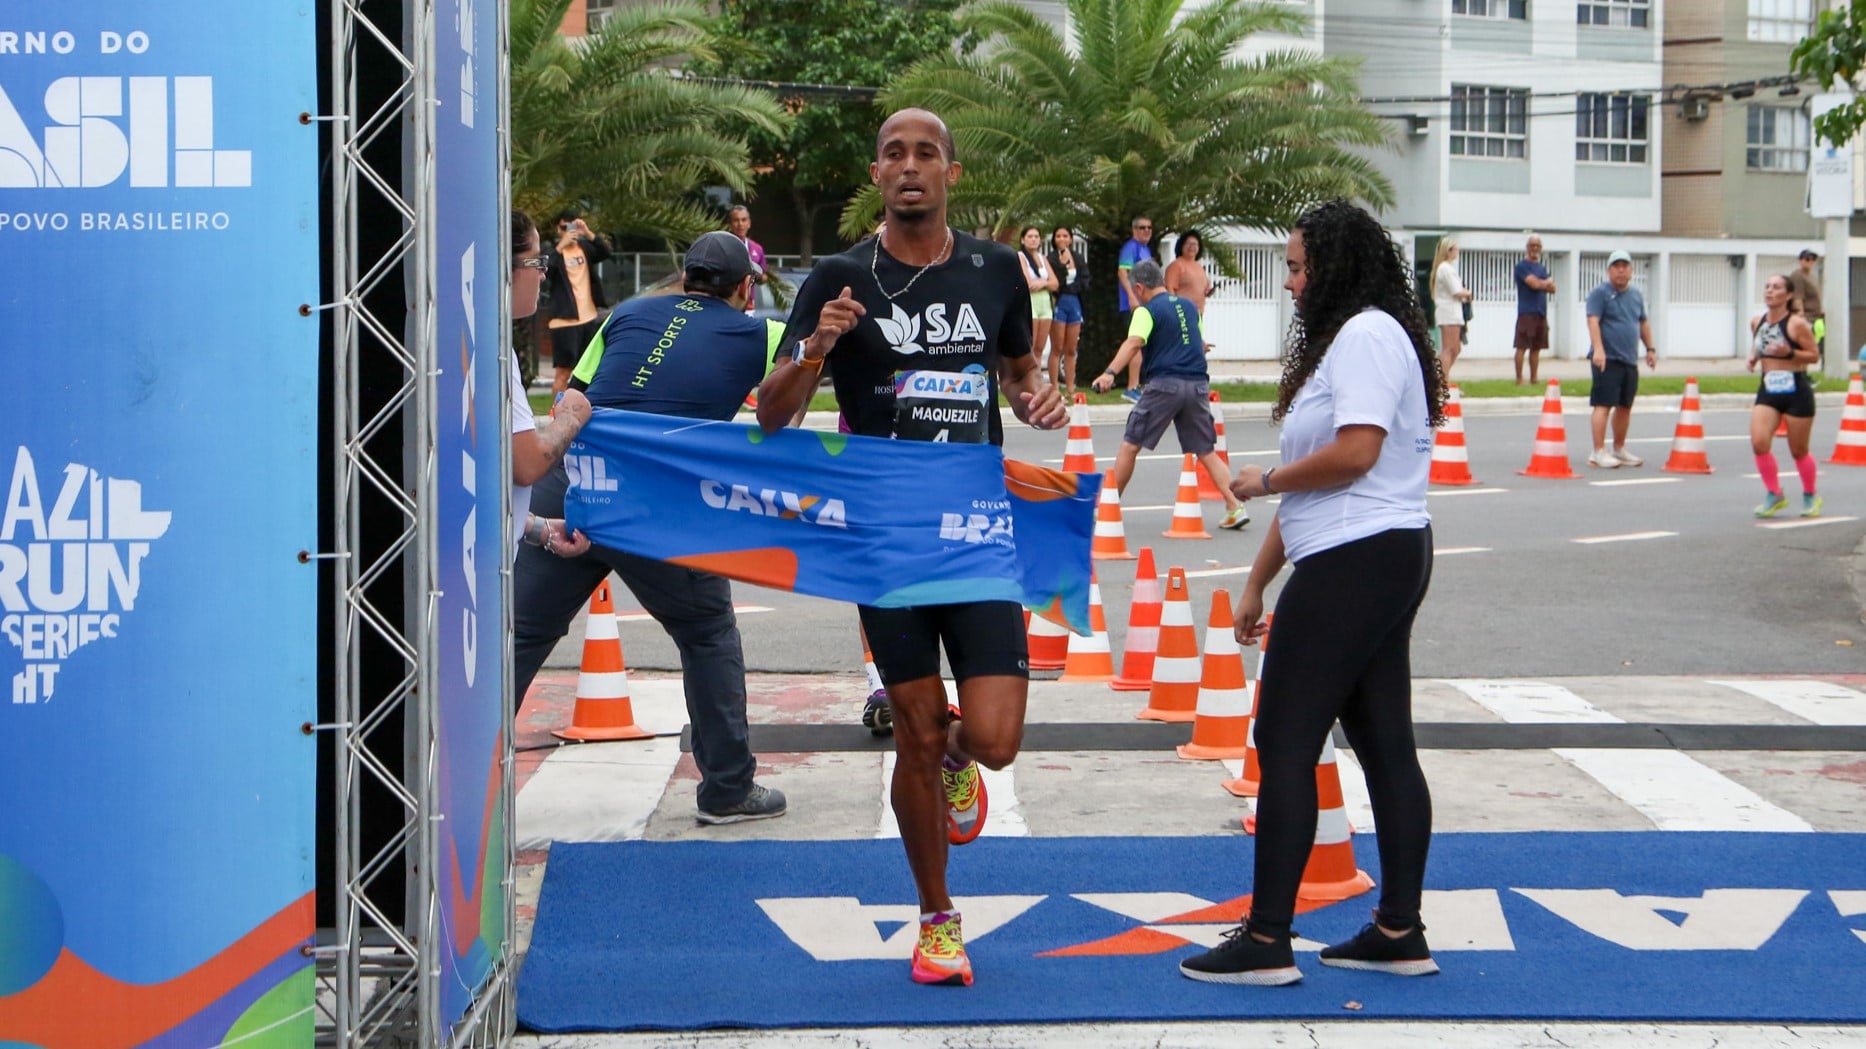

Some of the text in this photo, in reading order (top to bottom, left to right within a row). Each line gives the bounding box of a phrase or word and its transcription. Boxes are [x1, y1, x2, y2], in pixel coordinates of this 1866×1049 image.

[0, 31, 149, 54] RNO DO
[0, 212, 230, 231] POVO BRASILEIRO
[924, 302, 987, 344] SA
[631, 316, 687, 388] HT SPORTS
[928, 342, 985, 355] ambiental
[913, 376, 972, 394] CAIXA
[911, 406, 979, 424] MAQUEZILE
[461, 240, 477, 688] CAIXA
[700, 479, 849, 530] CAIXA
[939, 512, 1014, 545] BRA
[0, 542, 150, 613] RUN
[1, 614, 120, 660] SERIES
[754, 886, 1866, 961] AIXA
